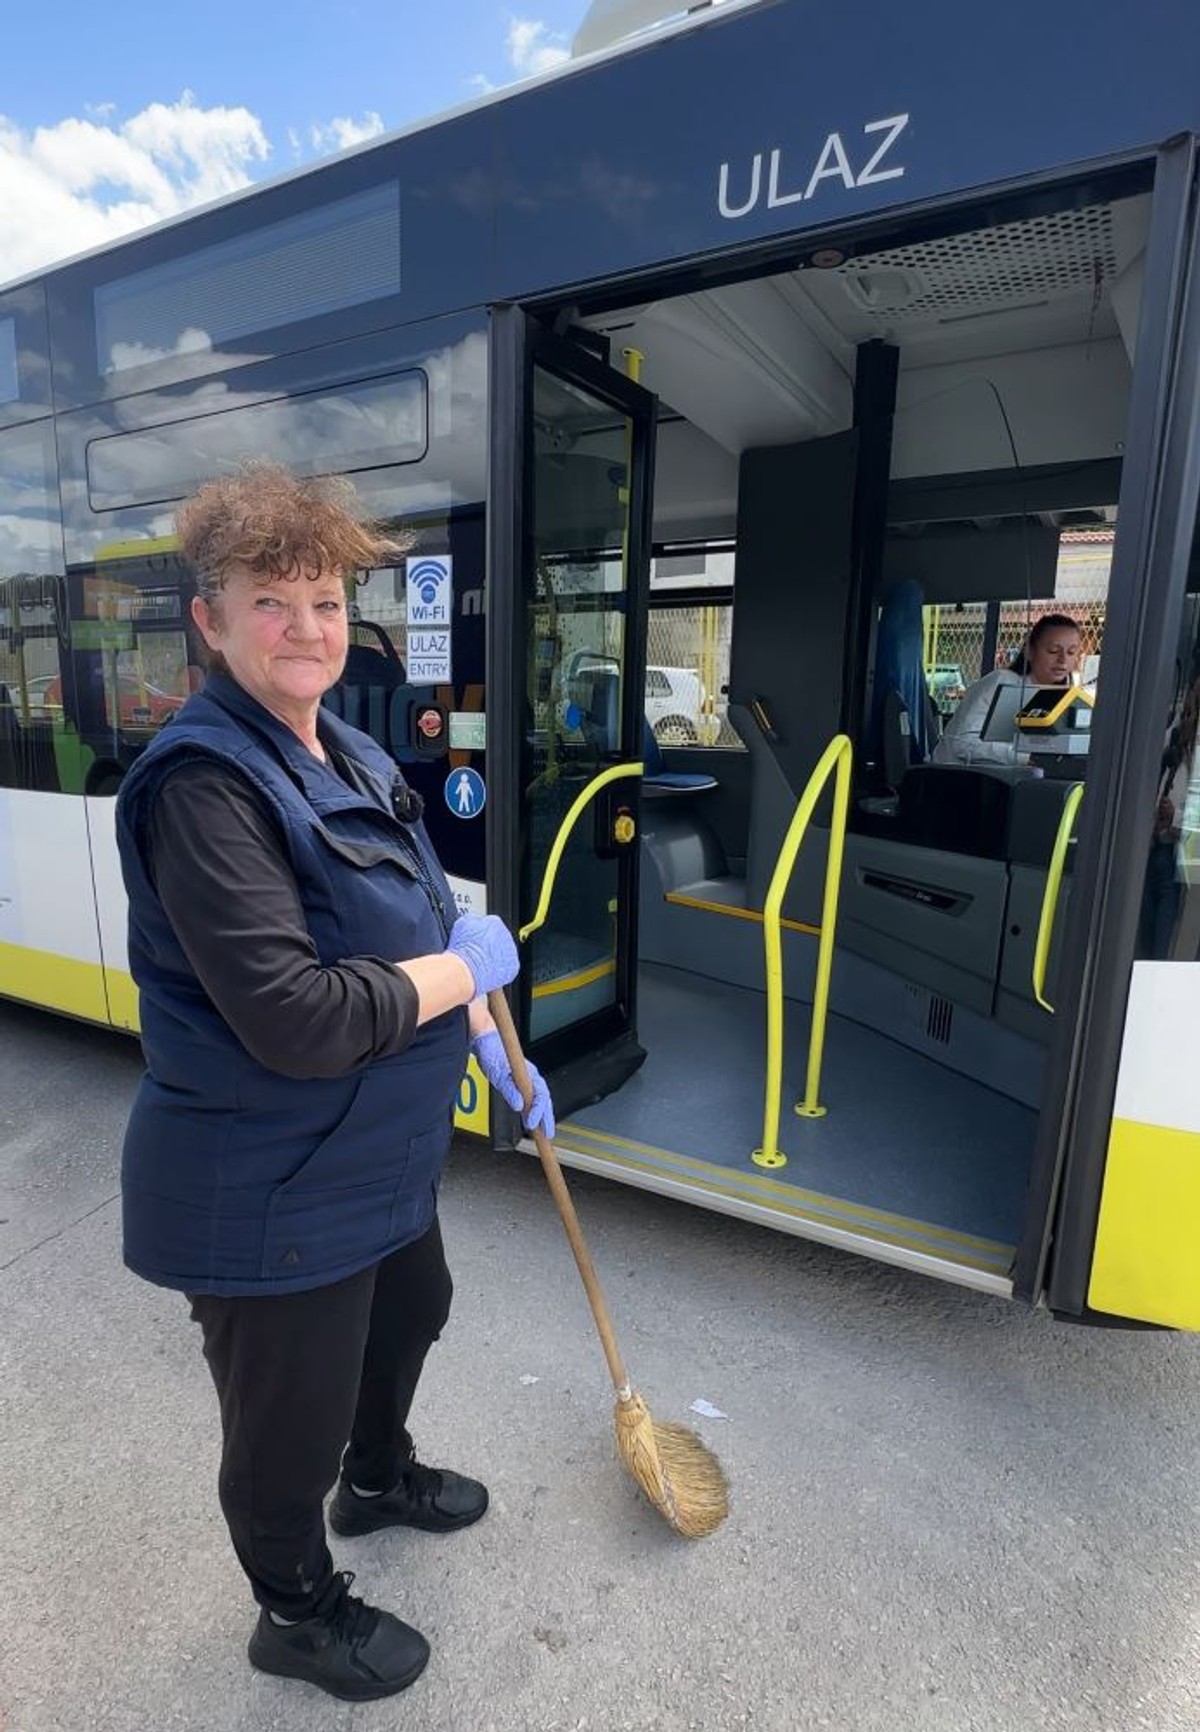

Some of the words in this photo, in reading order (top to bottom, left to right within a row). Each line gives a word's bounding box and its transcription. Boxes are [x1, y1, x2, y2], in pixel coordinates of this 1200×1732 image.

[717, 113, 910, 219] ULAZ
[412, 606, 445, 620] Wi-Fi
[410, 636, 448, 652] ULAZ
[410, 662, 448, 677] ENTRY
